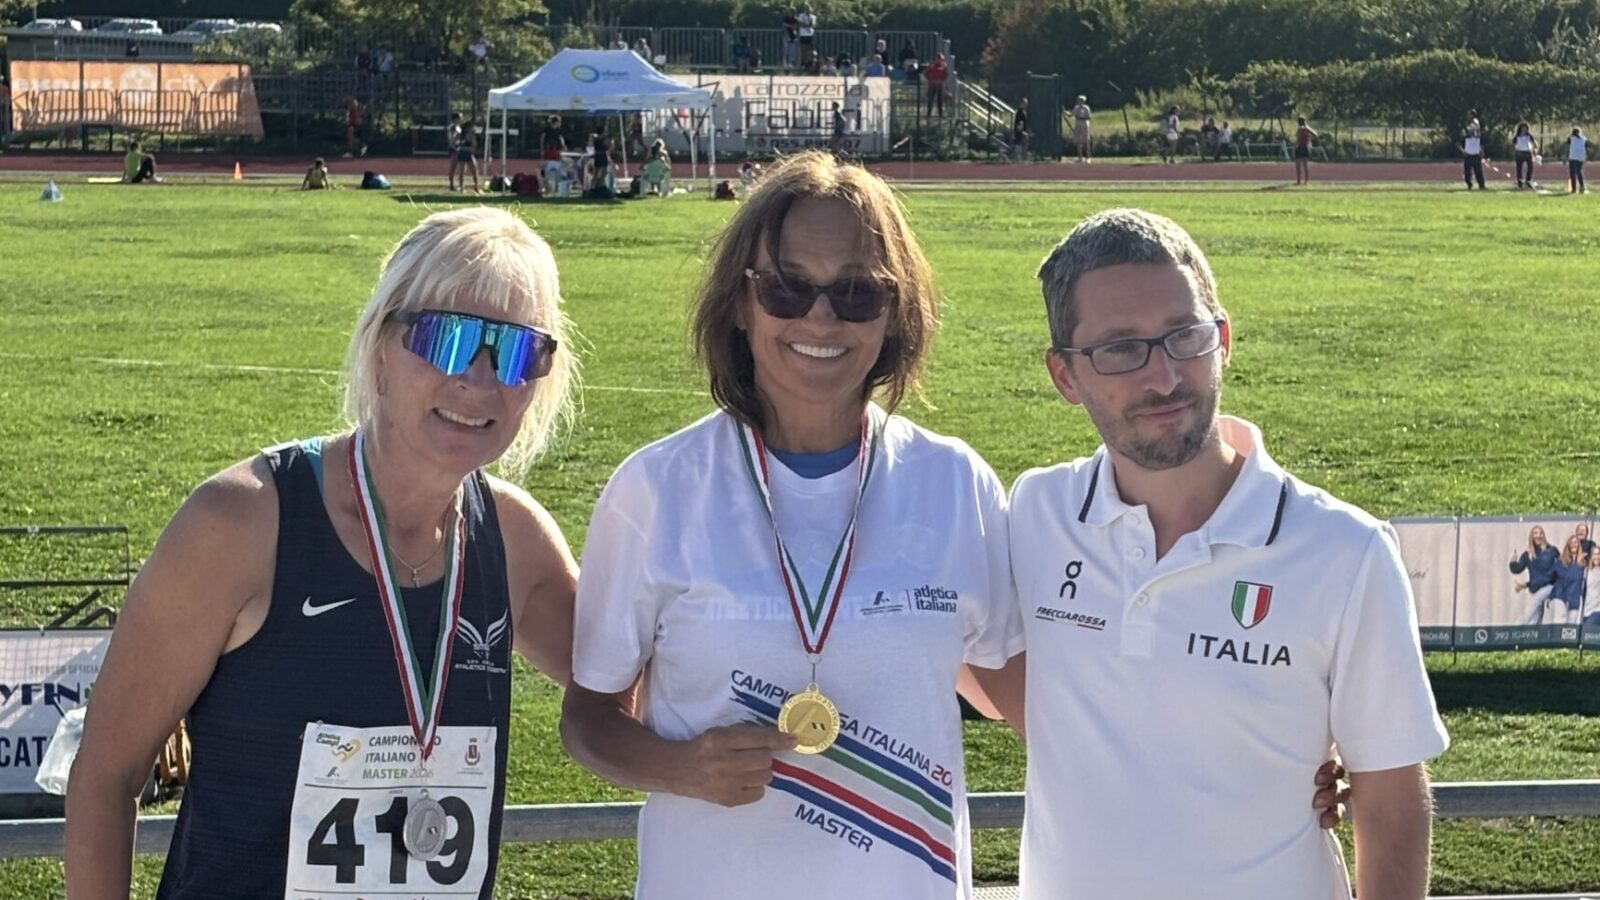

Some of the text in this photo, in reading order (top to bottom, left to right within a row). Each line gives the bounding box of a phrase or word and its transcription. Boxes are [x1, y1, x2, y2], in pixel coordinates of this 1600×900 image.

[744, 84, 862, 97] carozzera
[1036, 606, 1106, 627] FRECCIAROSSA
[1187, 632, 1292, 666] ITALIA
[68, 664, 99, 673] UFFICIA
[731, 668, 858, 736] CAMPISA
[862, 725, 930, 775] ITALIANA
[368, 735, 441, 747] CAMPIONO
[0, 736, 54, 768] CAT
[365, 751, 416, 763] ITALIANO
[362, 768, 408, 779] MASTER
[795, 804, 873, 852] MASTER
[306, 796, 475, 886] 419
